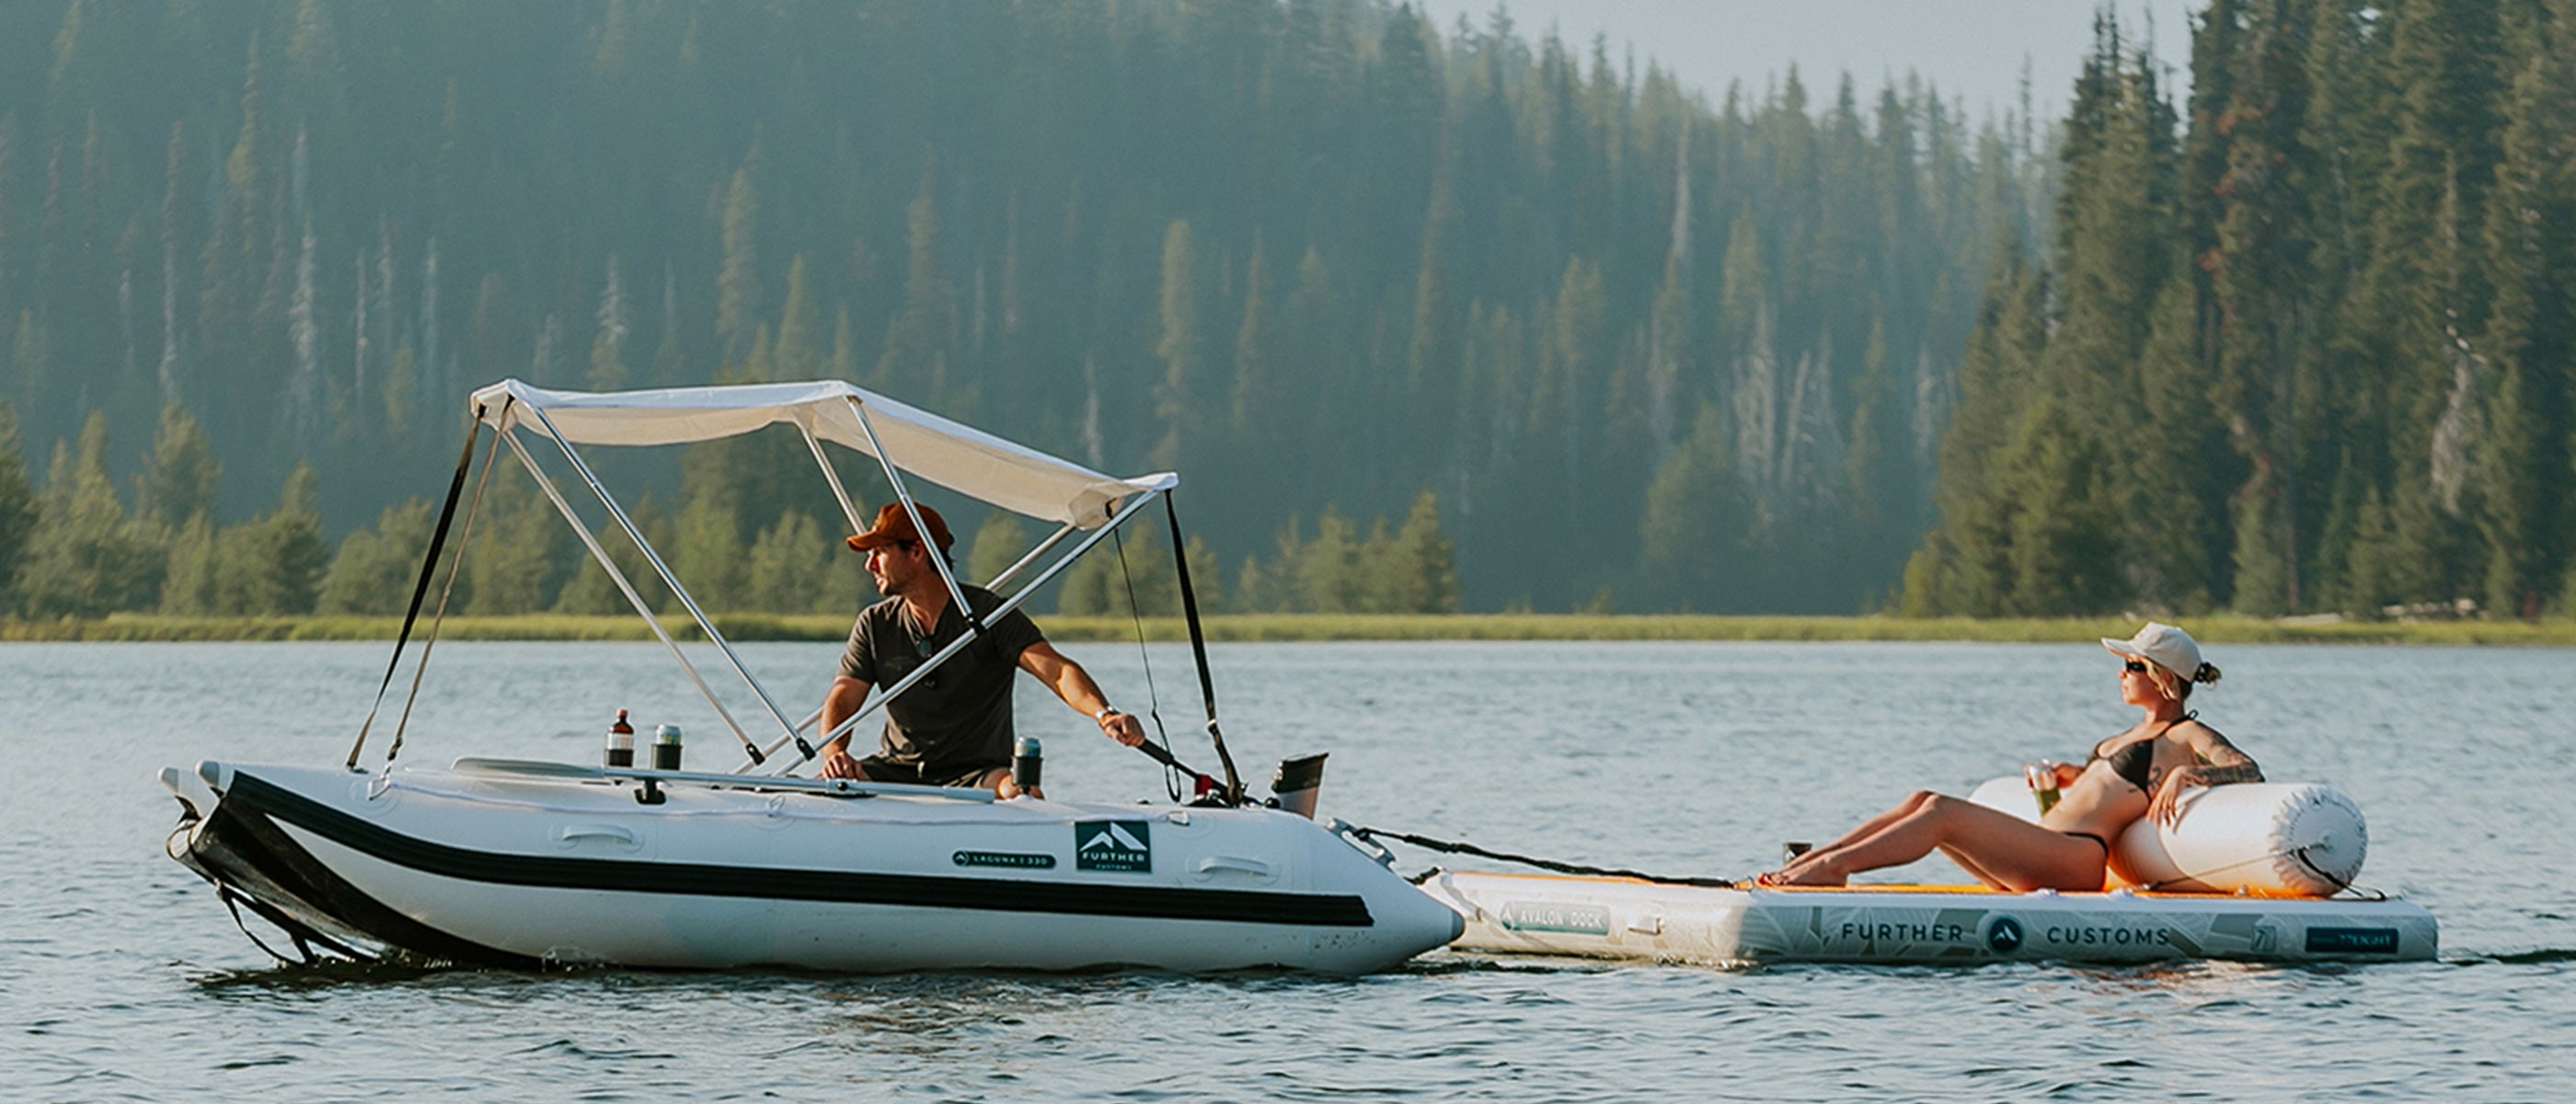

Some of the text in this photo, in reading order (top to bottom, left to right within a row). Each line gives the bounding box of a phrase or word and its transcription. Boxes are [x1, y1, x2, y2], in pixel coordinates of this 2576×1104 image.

[972, 855, 1017, 864] LAGUNA
[1028, 856, 1048, 866] 330
[1082, 852, 1144, 862] FURTHER
[1520, 909, 1564, 926] AVALON
[1842, 923, 2170, 946] FURTHER CUSTOMS
